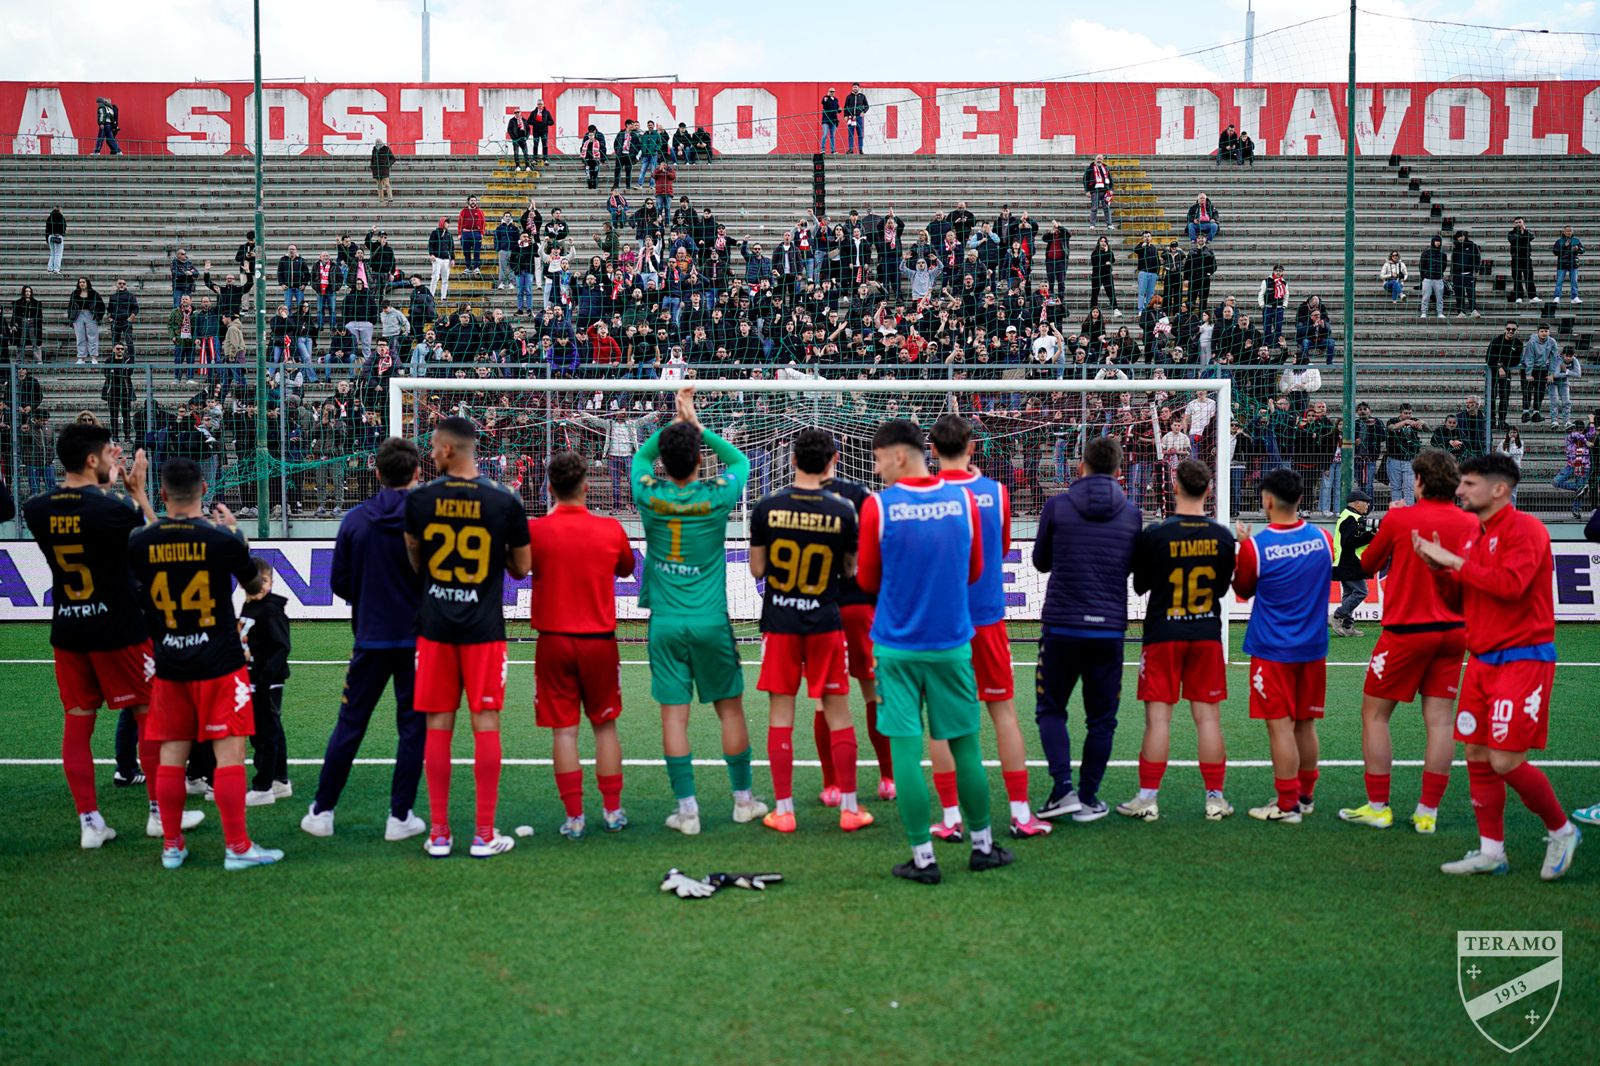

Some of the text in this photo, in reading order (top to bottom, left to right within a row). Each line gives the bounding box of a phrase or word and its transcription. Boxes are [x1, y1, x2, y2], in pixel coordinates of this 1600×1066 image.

[13, 86, 1600, 155] A SOSTEGNO DEL DIAVOL
[435, 498, 481, 519] MENNA
[889, 501, 963, 521] Kappa
[50, 516, 80, 534] PEPE
[666, 518, 685, 563] 1
[1169, 539, 1218, 558] D'AMORE
[1265, 538, 1324, 561] Kappa
[148, 542, 207, 563] ANGIULLI
[423, 523, 492, 584] 29
[53, 544, 94, 600] 5
[767, 538, 833, 596] 90
[150, 570, 217, 629] 44
[428, 584, 479, 603] HATRIA
[1166, 566, 1217, 616] 16
[162, 632, 210, 649] HATRIA
[1491, 698, 1514, 722] 10
